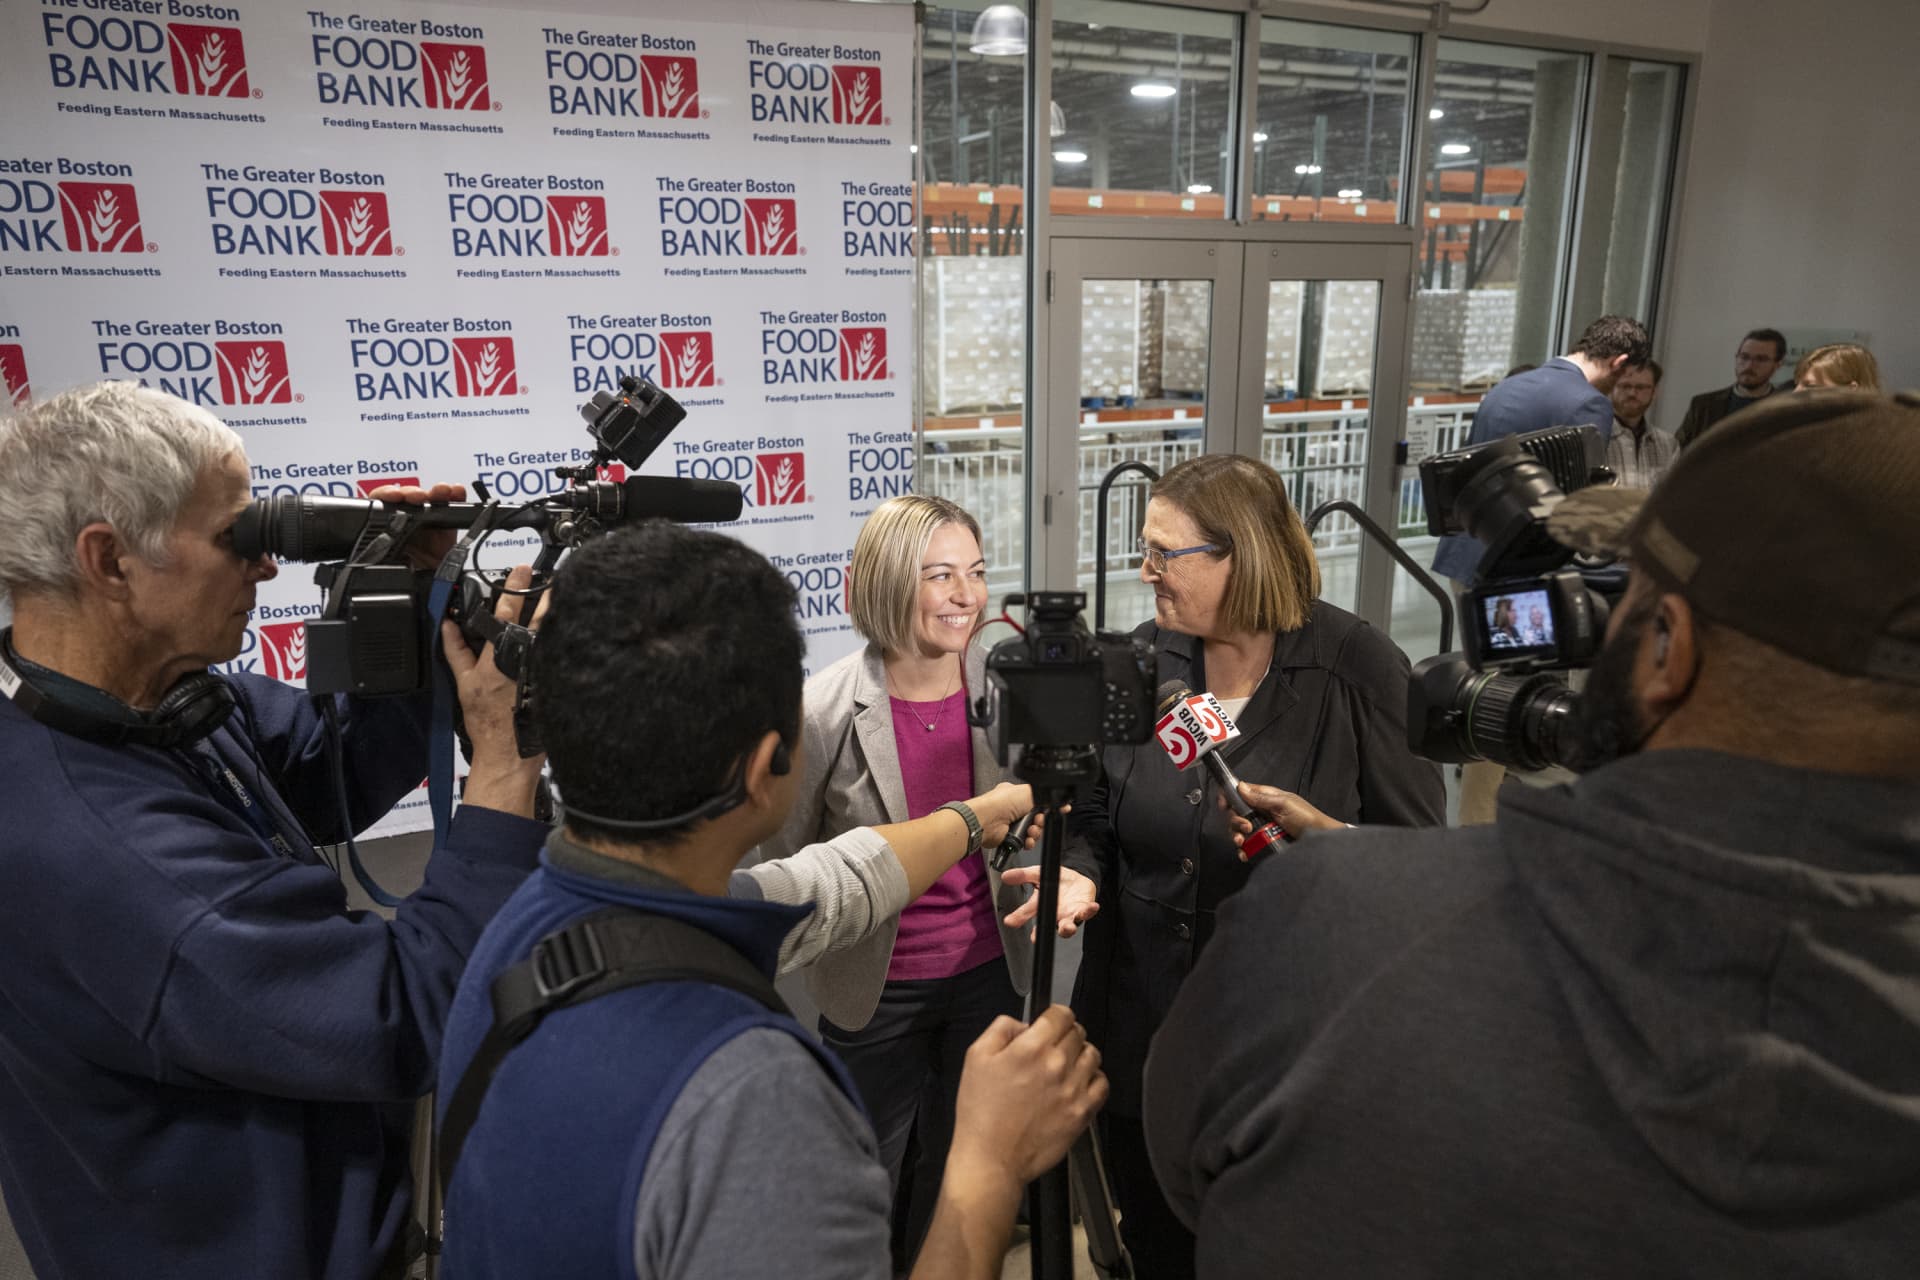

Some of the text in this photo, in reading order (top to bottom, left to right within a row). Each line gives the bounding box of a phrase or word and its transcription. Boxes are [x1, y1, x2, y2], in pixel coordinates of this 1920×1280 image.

[82, 0, 240, 21] Greater Boston
[42, 12, 164, 53] FOOD
[307, 11, 483, 39] The Greater Boston
[542, 28, 696, 51] The Greater Boston
[747, 40, 881, 61] The Greater Boston
[312, 34, 417, 71] FOOD
[48, 53, 171, 94] BANK
[546, 50, 637, 83] FOOD
[749, 61, 828, 92] FOOD
[317, 72, 422, 108] BANK
[549, 85, 640, 118] BANK
[57, 102, 266, 123] Feeding Eastern Massachusetts
[751, 93, 830, 124] BANK
[323, 117, 504, 134] Feeding Eastern Massachusetts
[553, 127, 710, 140] Feeding Eastern Massachusetts
[753, 133, 891, 146] Feeding Eastern Massachusetts
[57, 158, 133, 177] Boston
[201, 163, 385, 186] The Greater Boston
[444, 172, 604, 190] The Greater Boston
[656, 177, 795, 193] The Greater Boston
[841, 181, 912, 196] The Greate
[206, 186, 316, 220] FOOD
[448, 193, 544, 223] FOOD
[659, 197, 742, 225] FOOD
[843, 200, 913, 227] FOOD
[212, 223, 321, 256] BANK
[452, 228, 548, 257] BANK
[661, 229, 743, 257] BANK
[844, 231, 913, 257] BANK
[4, 265, 58, 276] Eastern
[61, 266, 161, 276] Massachusetts
[218, 268, 407, 279] Feeding Eastern Massachusetts
[457, 268, 621, 279] Feeding Eastern Massachusetts
[664, 267, 807, 278] Feeding Eastern Massachusetts
[845, 268, 878, 277] Feeding
[92, 320, 283, 337] The Greater Boston
[346, 317, 512, 333] The Greater Boston
[568, 313, 711, 330] The Greater Boston
[760, 310, 887, 325] The Greater Boston
[350, 338, 450, 367] FOOD
[570, 333, 657, 361] FOOD
[761, 328, 837, 355] FOOD
[98, 341, 212, 373] FOOD
[763, 357, 837, 384] BANK
[355, 370, 453, 401] BANK
[765, 391, 895, 404] Feeding Eastern Massachusetts
[360, 407, 530, 422] Feeding Eastern Massachusetts
[673, 437, 804, 455] The Greater Boston
[847, 431, 912, 445] The Greate
[251, 459, 418, 480] The Greater Boston
[474, 452, 505, 467] The
[508, 450, 568, 465] Greater
[675, 455, 753, 481] FOOD
[849, 447, 913, 473] FOOD
[477, 468, 567, 497] FOOD
[849, 475, 914, 500] BANK
[751, 513, 815, 524] Massachusetts
[485, 538, 525, 548] Feeding
[770, 555, 794, 567] The
[796, 552, 844, 566] Greater
[784, 567, 843, 593] OOD
[259, 604, 322, 620] Boston
[792, 593, 842, 619] ANK
[1207, 697, 1235, 732] WCVB
[1178, 707, 1209, 747] WCVB
